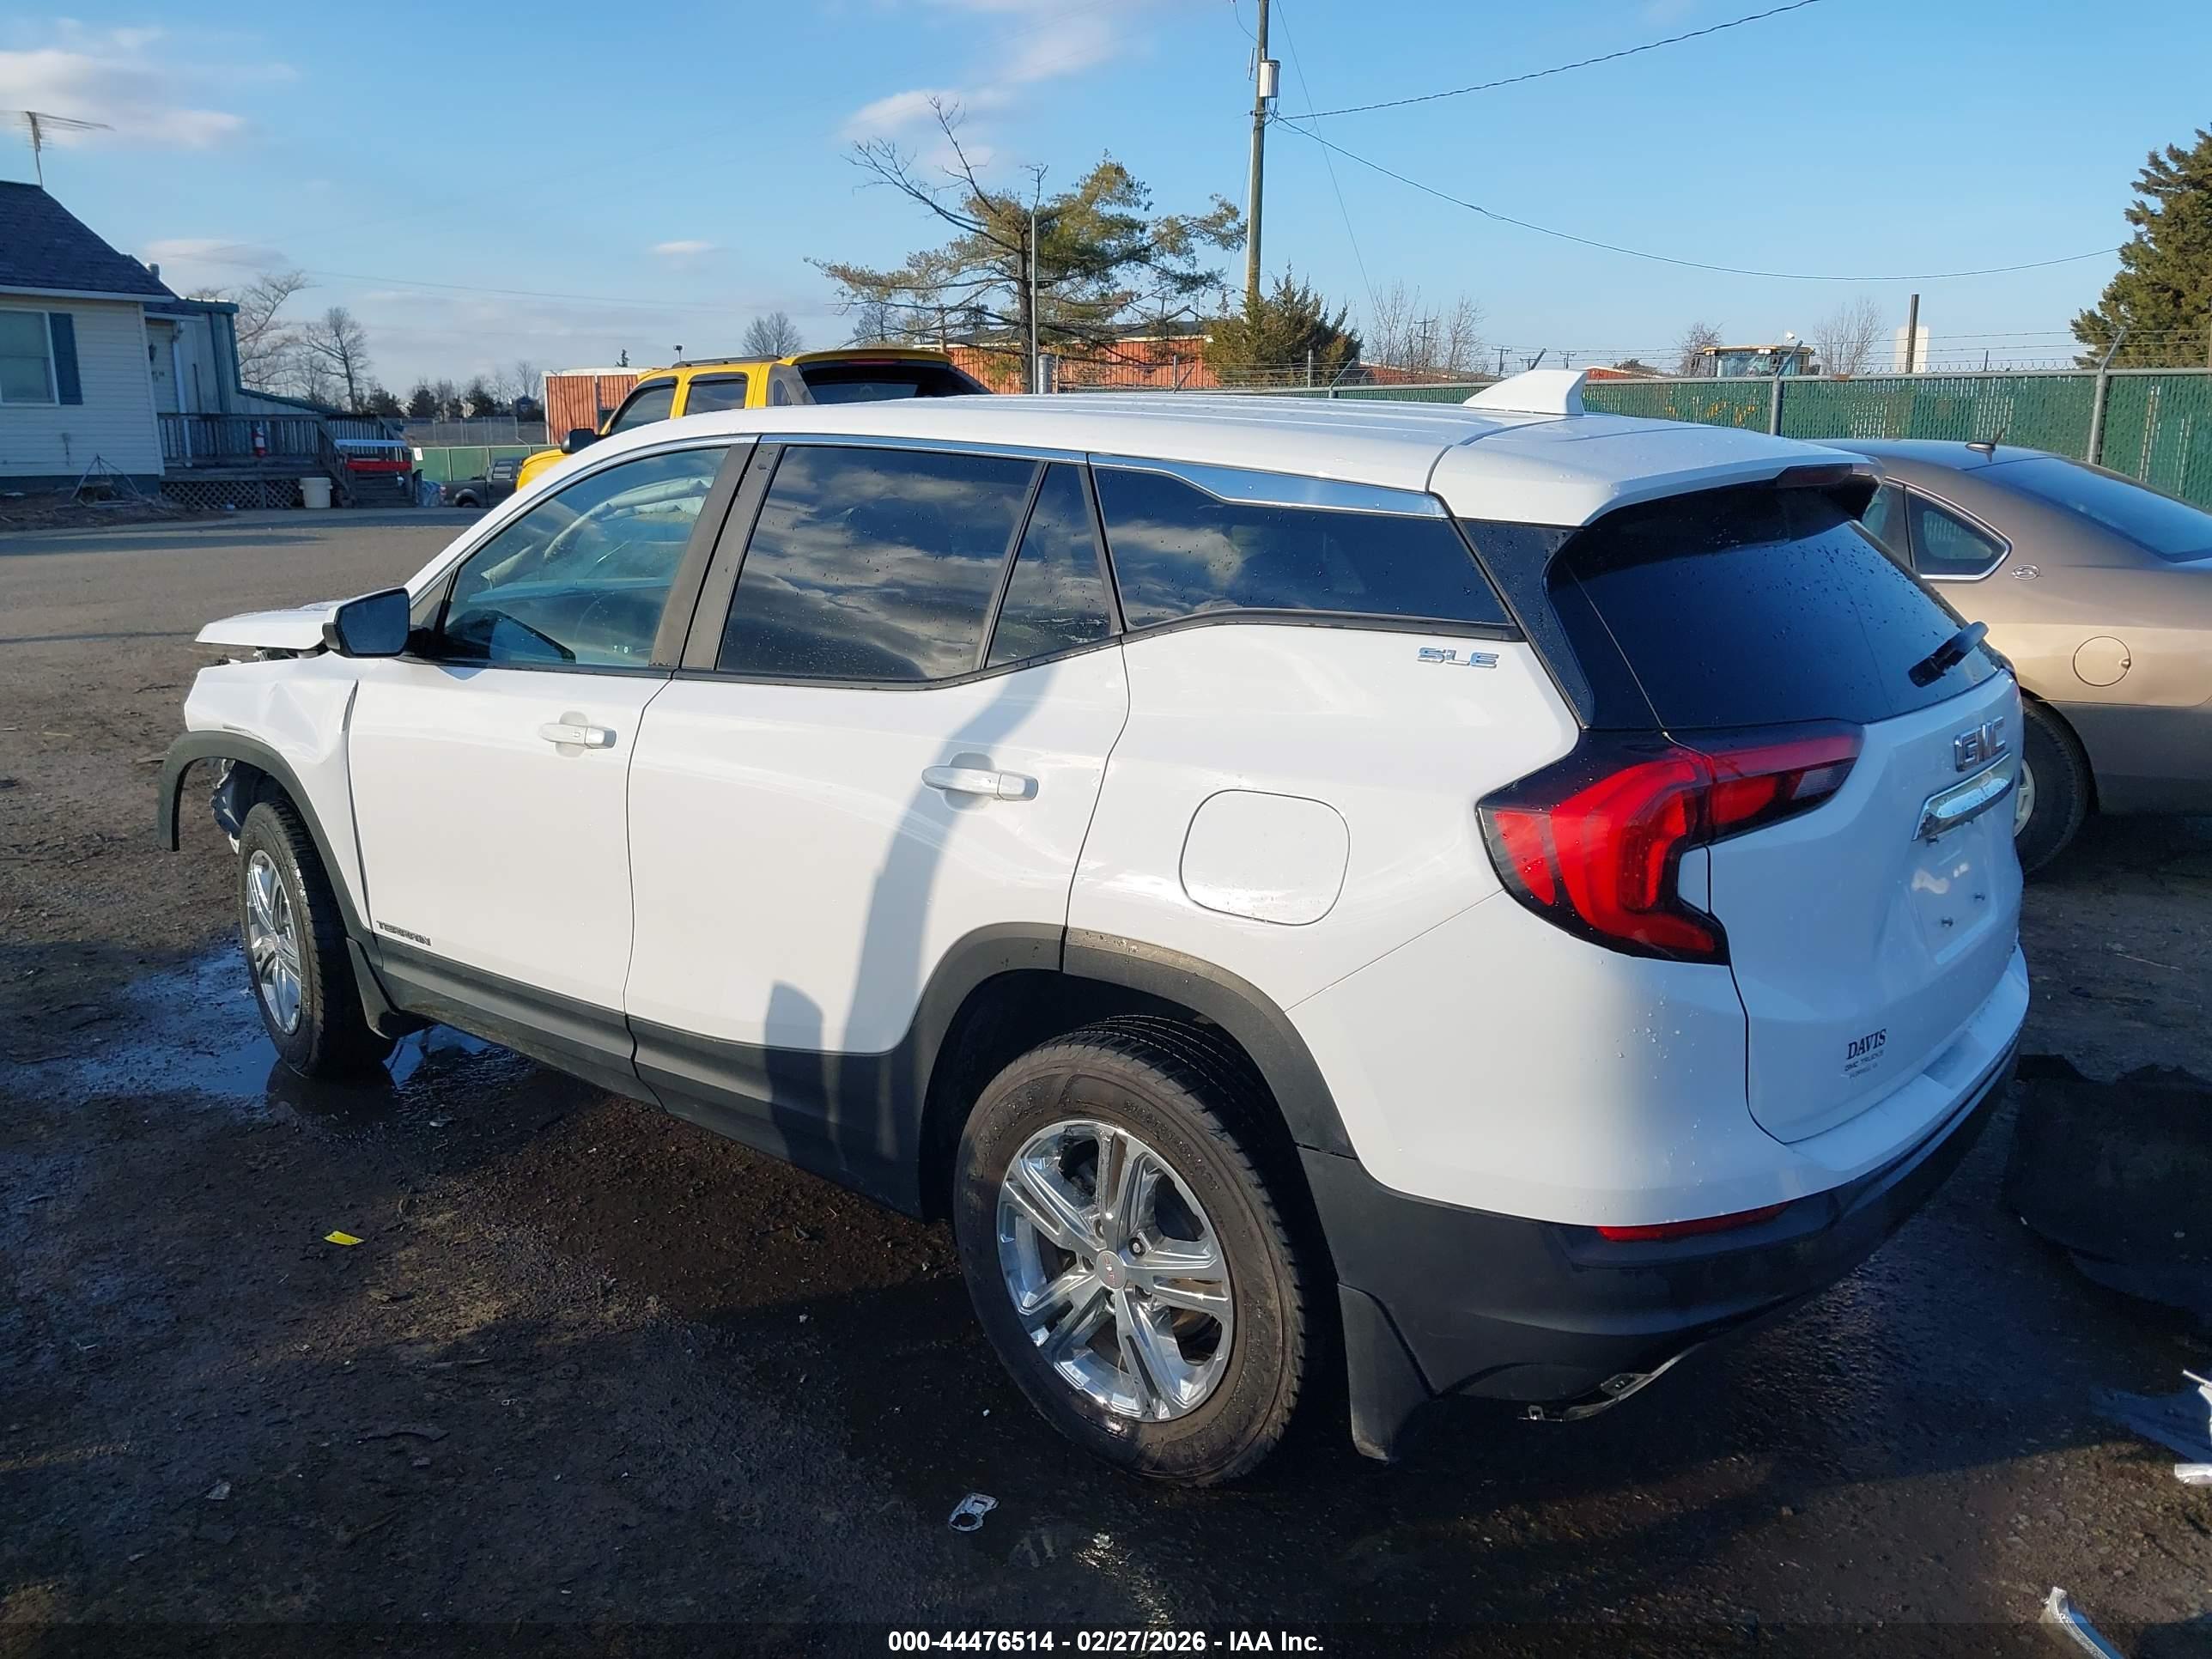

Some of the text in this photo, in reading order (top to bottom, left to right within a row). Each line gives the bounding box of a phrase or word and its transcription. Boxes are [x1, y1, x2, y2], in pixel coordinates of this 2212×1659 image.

[1417, 647, 1499, 668] SLE
[1954, 716, 2007, 772] GMC
[1846, 1029, 1887, 1060] DAVIS
